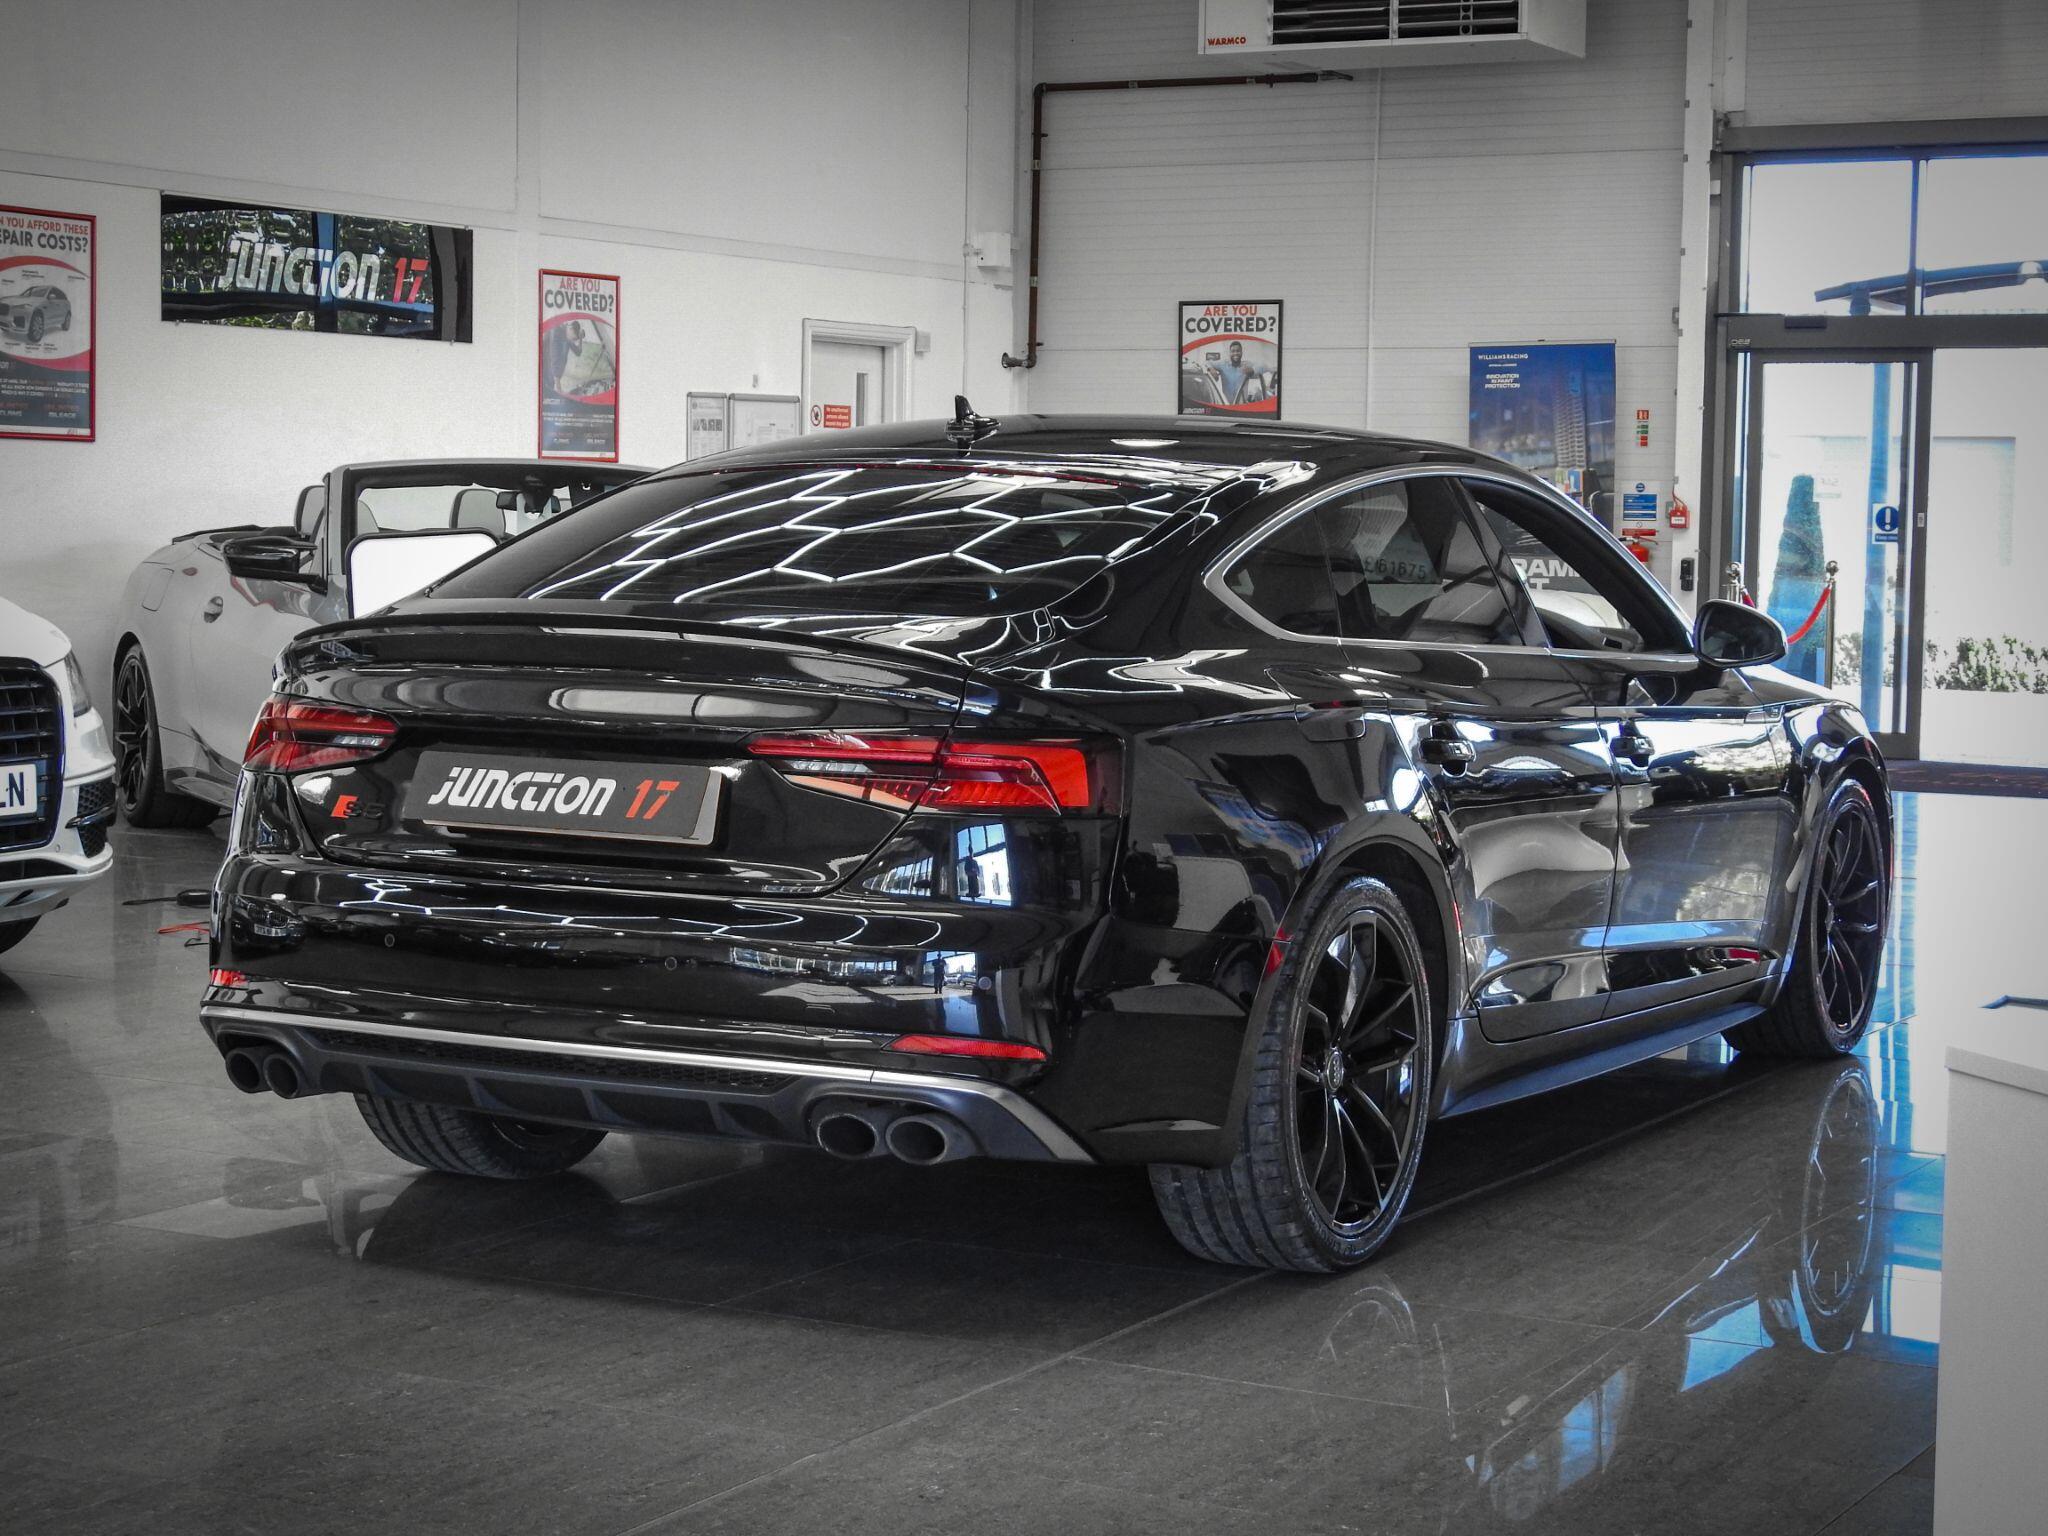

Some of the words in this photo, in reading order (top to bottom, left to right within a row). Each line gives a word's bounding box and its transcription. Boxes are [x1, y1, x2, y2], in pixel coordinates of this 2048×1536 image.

[1208, 37, 1246, 46] WARMCO
[7, 217, 24, 228] YOU
[27, 220, 61, 232] AFFORD
[64, 223, 88, 235] THESE
[0, 229, 33, 247] PAIR
[38, 233, 88, 253] COSTS?
[393, 257, 429, 304] 17
[560, 277, 578, 291] ARE
[581, 279, 600, 292] YOU
[545, 290, 614, 313] COVERED?
[1203, 306, 1228, 316] ARE
[1232, 305, 1257, 316] YOU
[1185, 316, 1276, 333] COVERED?
[625, 779, 680, 820] 17
